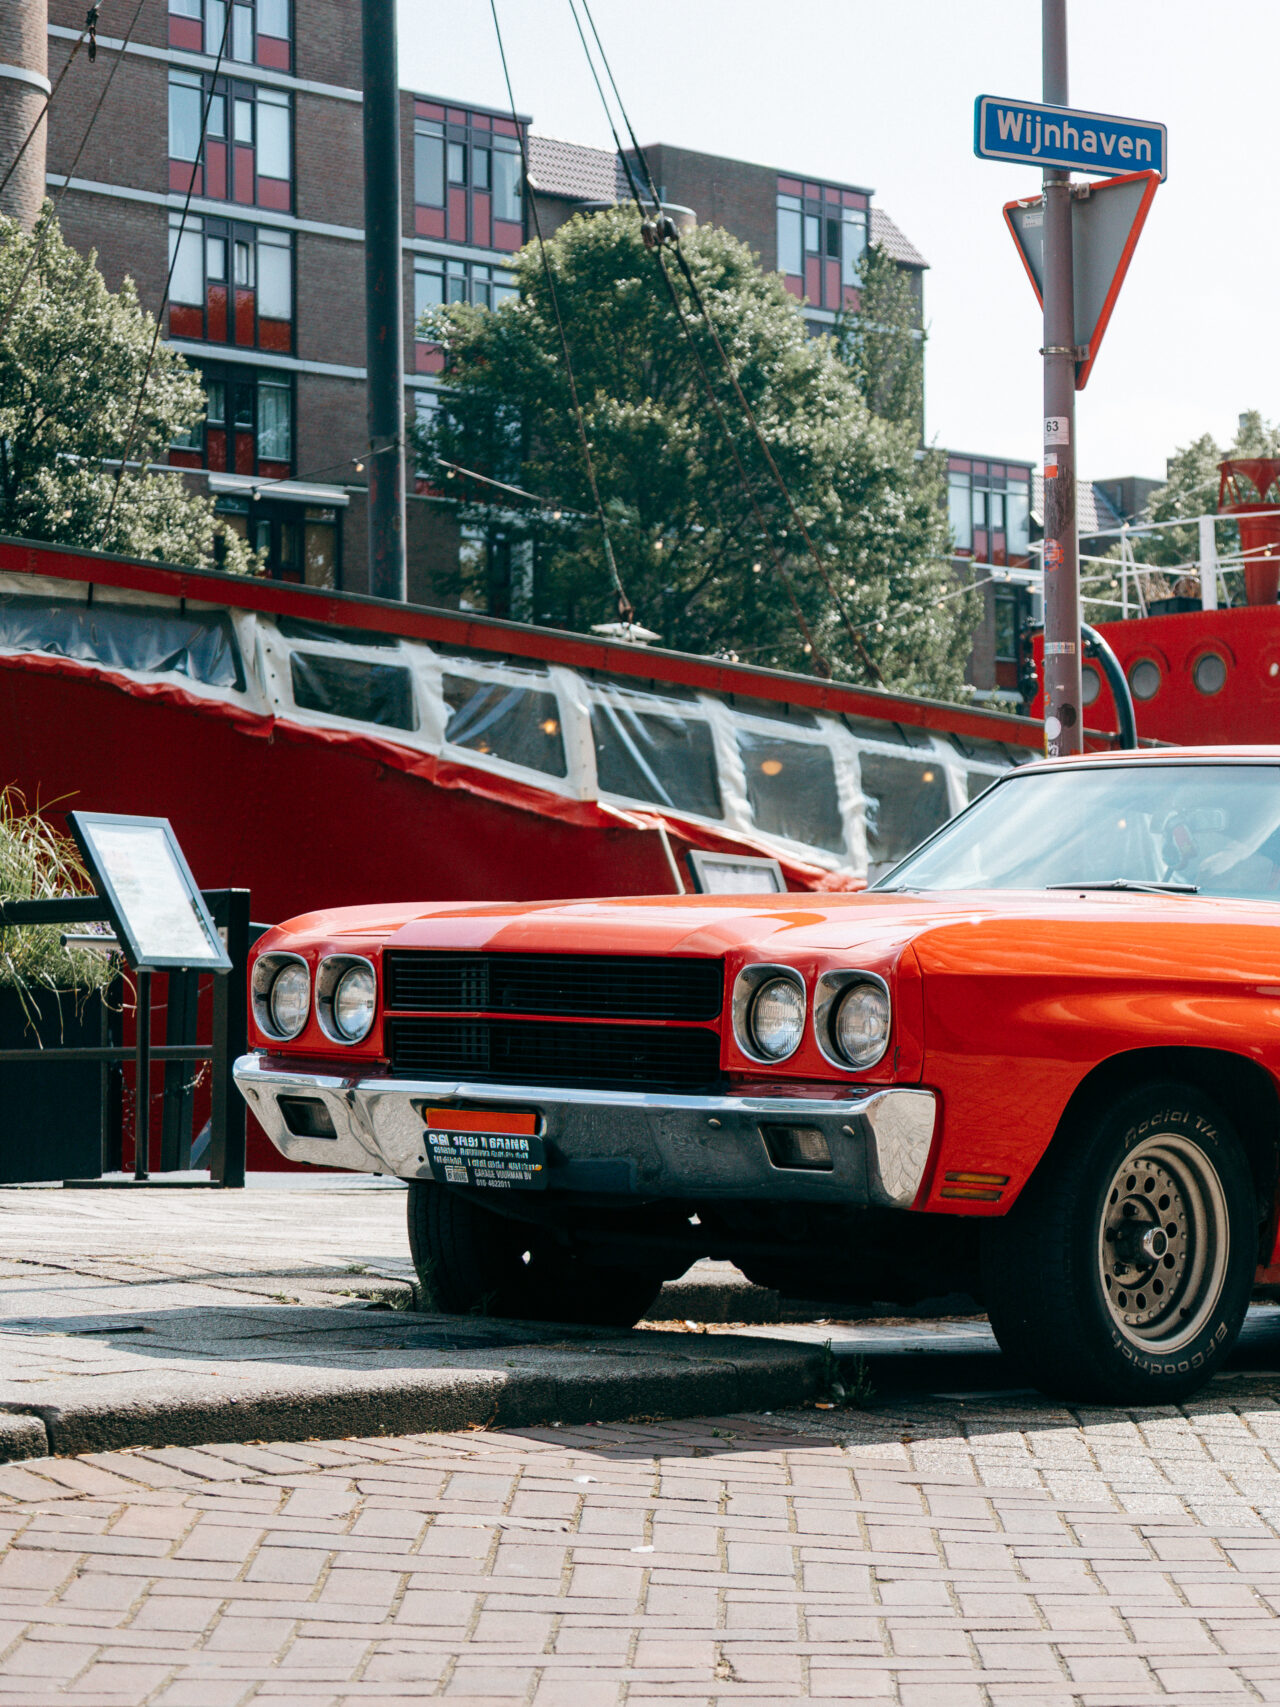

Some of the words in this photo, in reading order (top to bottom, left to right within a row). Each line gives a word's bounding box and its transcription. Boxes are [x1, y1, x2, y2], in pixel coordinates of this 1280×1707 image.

[997, 109, 1152, 162] Wijnhaven
[1046, 421, 1059, 432] 63
[1125, 1109, 1189, 1148] Radial
